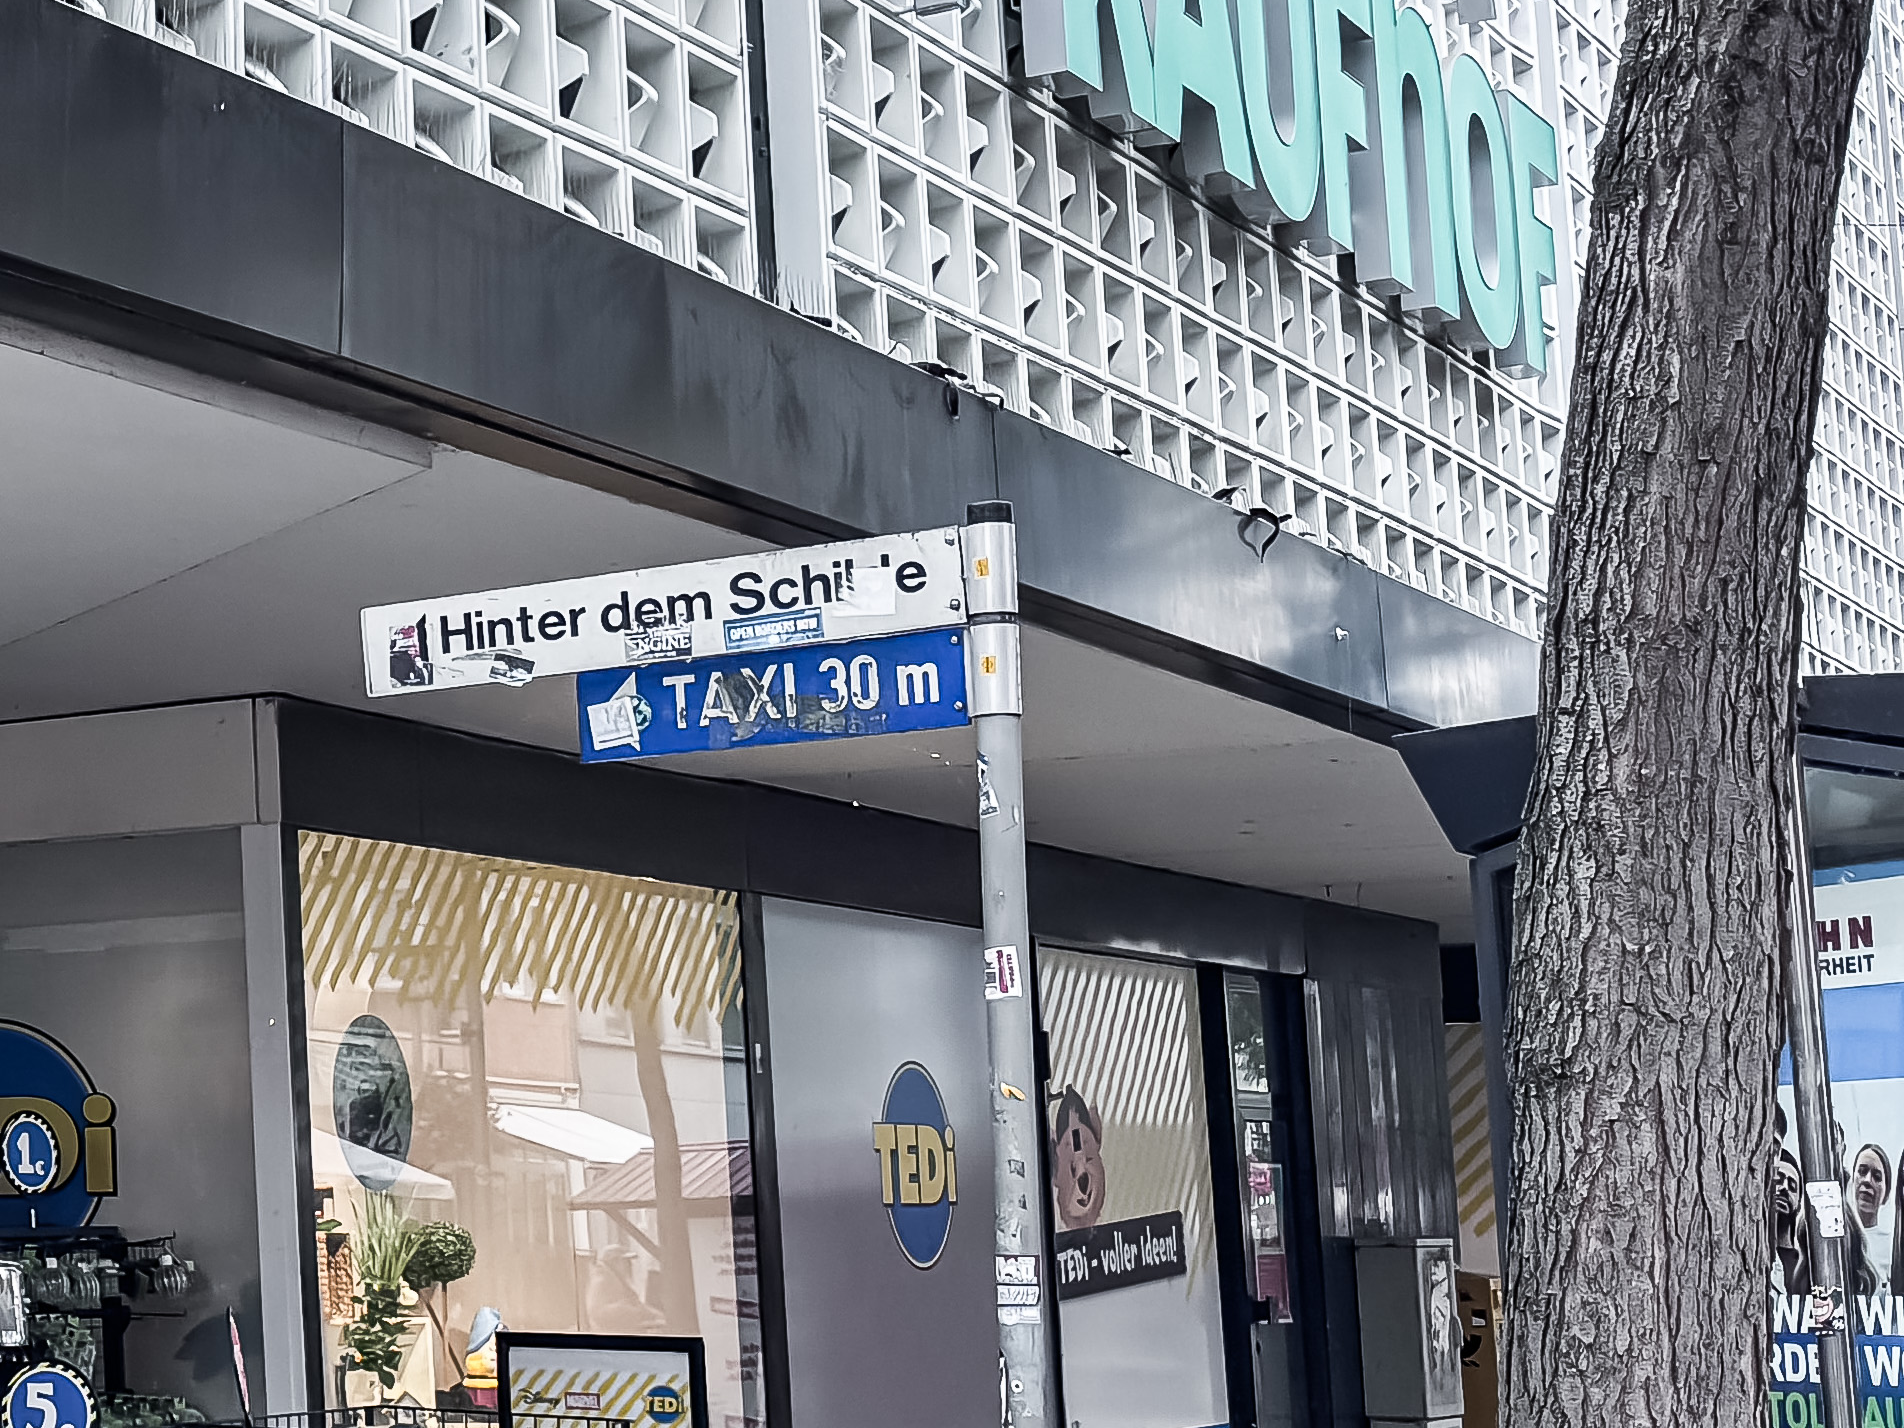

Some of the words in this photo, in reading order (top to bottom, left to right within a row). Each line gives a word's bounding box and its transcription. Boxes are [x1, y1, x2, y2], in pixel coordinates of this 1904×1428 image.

[439, 606, 586, 655] Hinter
[600, 590, 713, 634] dem
[662, 662, 798, 729] TAXI
[818, 654, 880, 714] 30
[895, 661, 940, 707] m
[1815, 915, 1874, 953] HN
[1819, 953, 1875, 976] RHEIT
[872, 1122, 958, 1206] TEDi
[1100, 1230, 1138, 1276] voller
[1140, 1225, 1177, 1267] Ideen!
